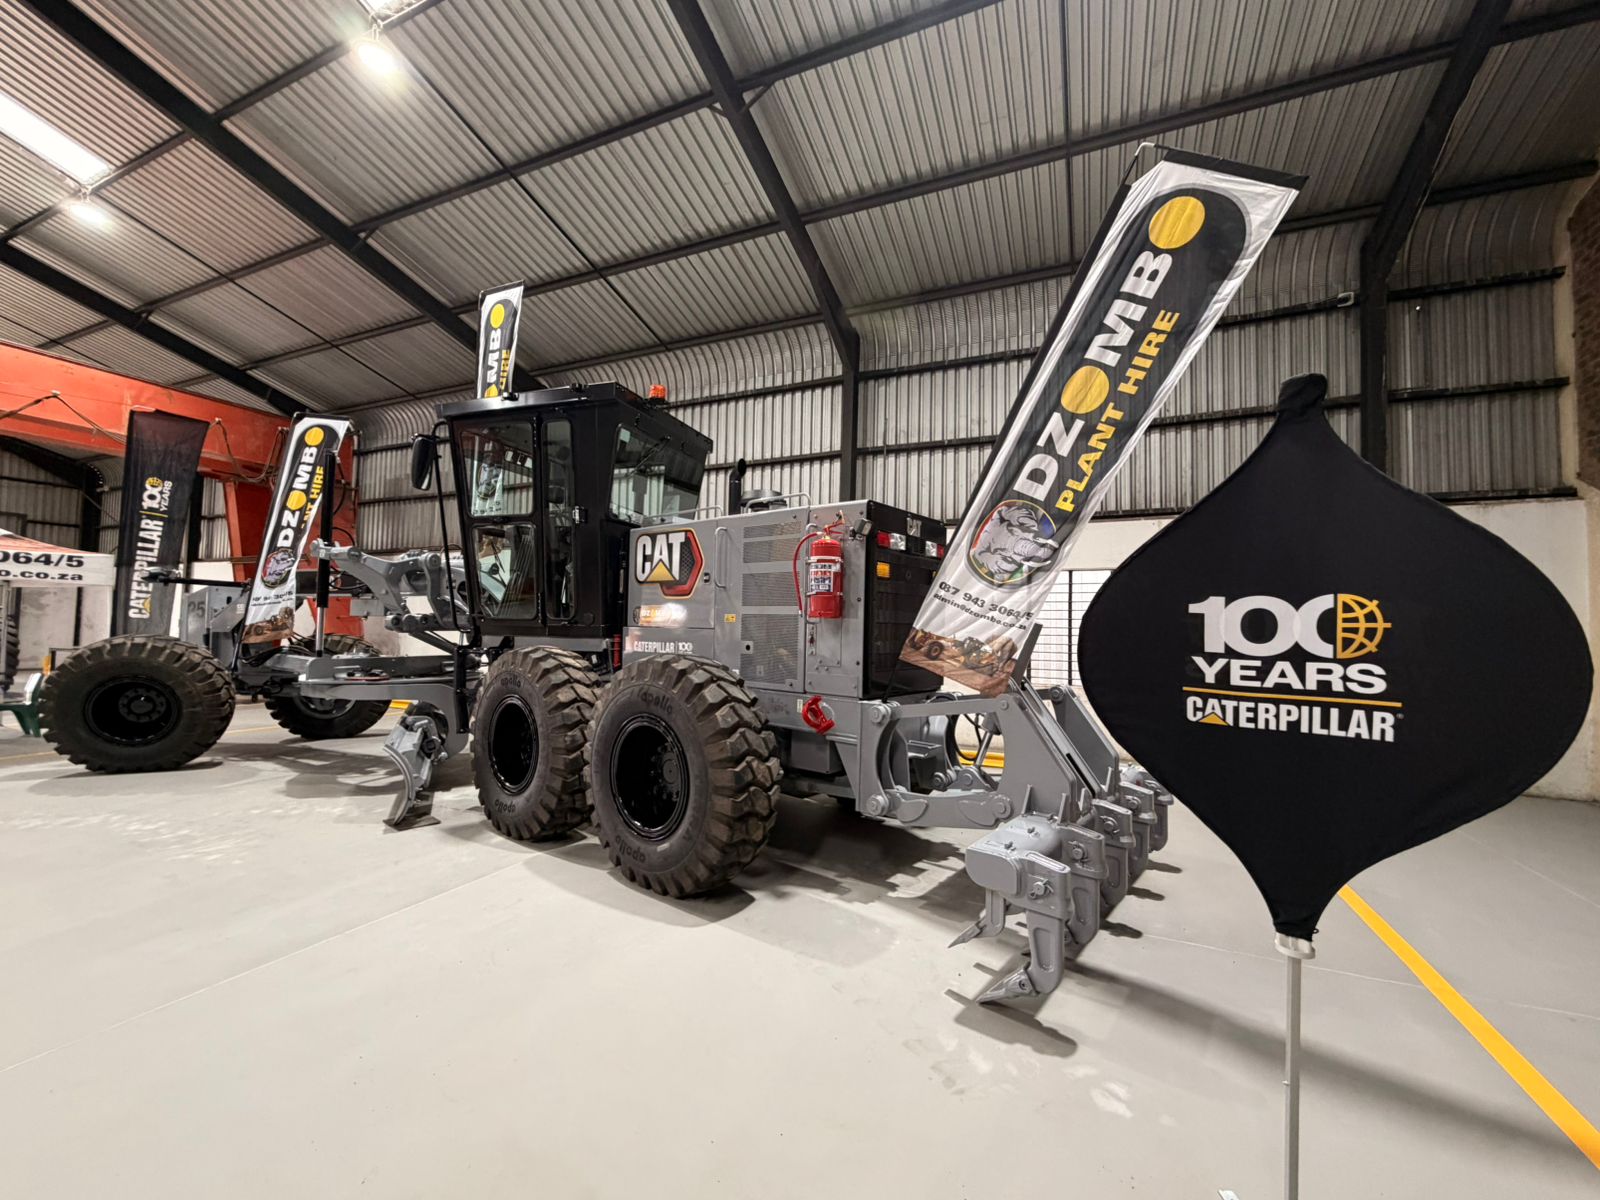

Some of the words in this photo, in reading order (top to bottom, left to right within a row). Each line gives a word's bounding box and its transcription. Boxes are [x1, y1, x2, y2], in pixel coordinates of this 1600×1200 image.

[1055, 402, 1125, 513] PLANT
[1117, 309, 1180, 395] HIRE
[160, 480, 173, 513] YEARS
[636, 531, 686, 582] CAT
[962, 592, 986, 609] 943
[634, 641, 675, 653] CATERPILLAR
[1188, 593, 1393, 660] 100
[1191, 656, 1388, 695] YEARS
[1185, 695, 1396, 743] CATERPILLAR
